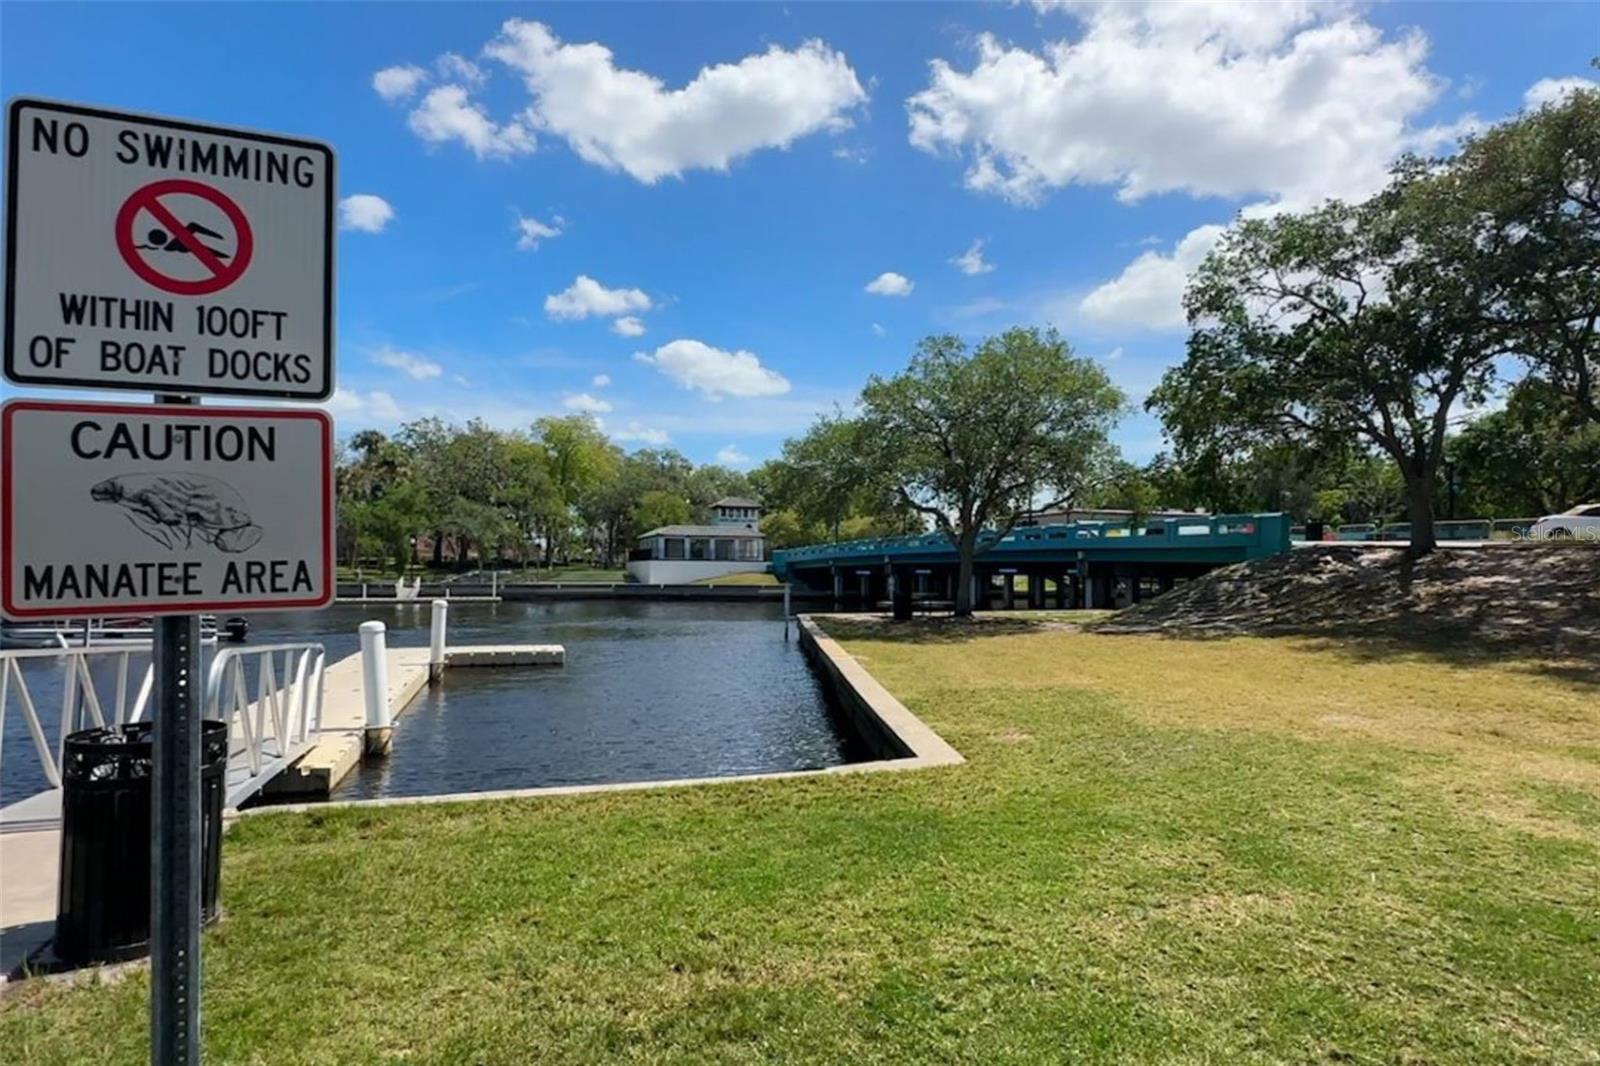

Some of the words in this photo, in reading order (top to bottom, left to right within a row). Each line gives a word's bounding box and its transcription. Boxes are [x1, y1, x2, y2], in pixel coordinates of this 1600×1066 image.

[32, 117, 89, 157] NO
[116, 130, 315, 188] SWIMMING
[59, 292, 173, 332] WITHIN
[197, 305, 288, 340] 100FT
[29, 335, 76, 369] OF
[100, 340, 186, 376] BOAT
[208, 348, 312, 384] DOCKS
[70, 420, 275, 461] CAUTION
[24, 562, 202, 600] MANATEE
[221, 560, 313, 595] AREA
